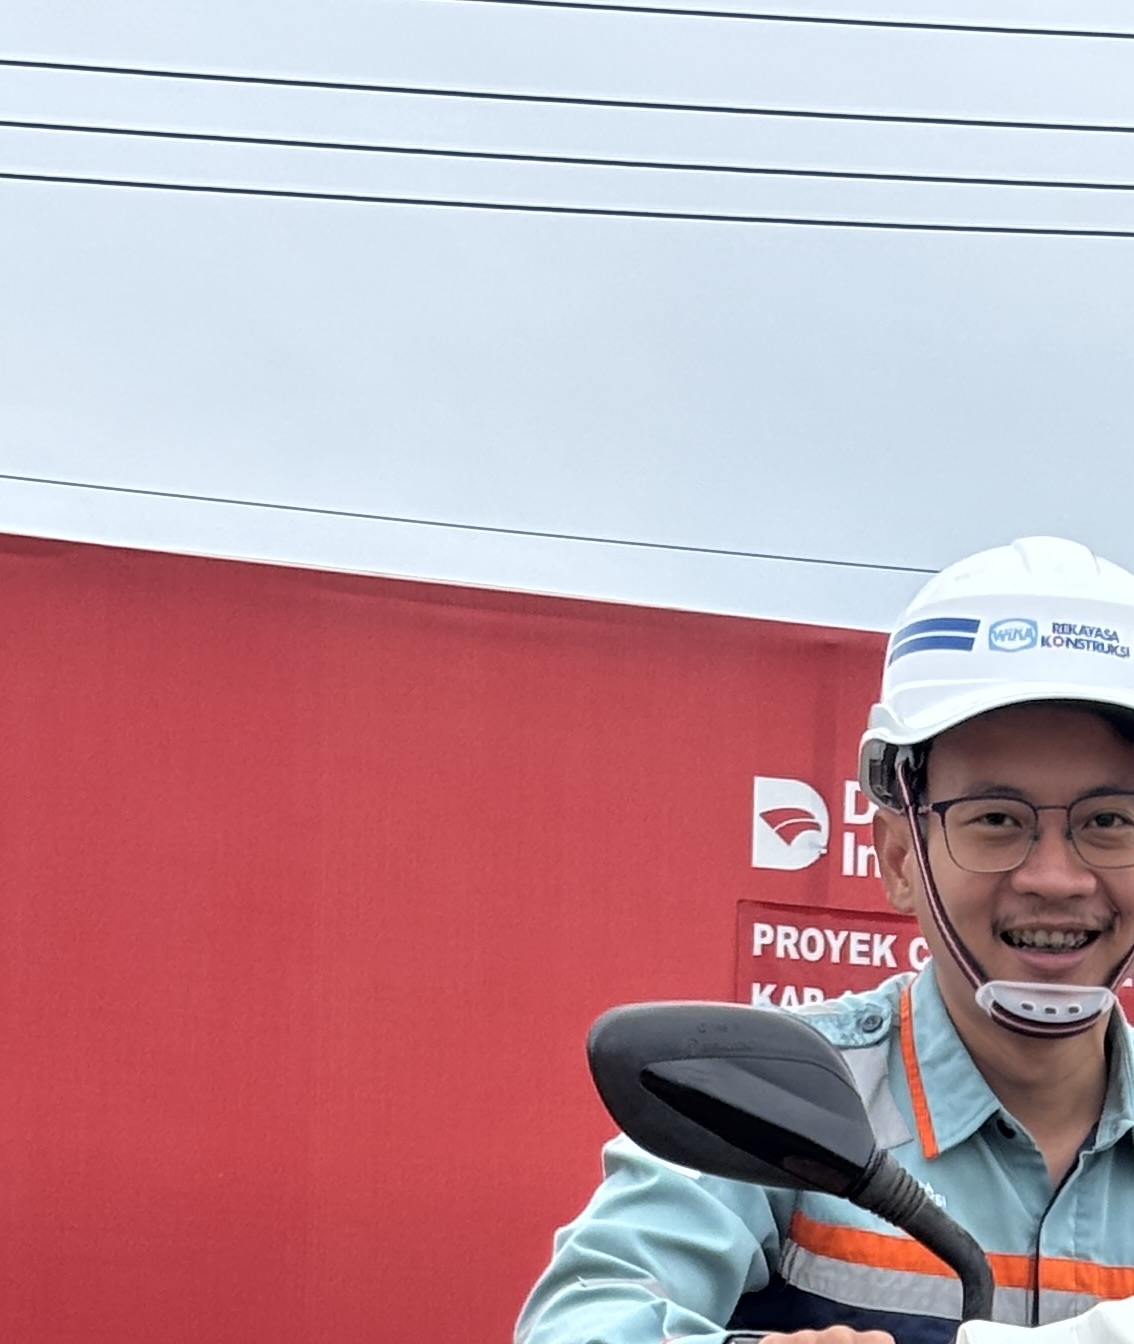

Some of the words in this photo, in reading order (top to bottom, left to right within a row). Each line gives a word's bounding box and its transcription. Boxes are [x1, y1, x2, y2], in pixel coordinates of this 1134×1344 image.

[1051, 622, 1119, 643] REKAYASA
[1041, 635, 1131, 659] KONSTRUKSI
[752, 922, 898, 968] PROYEK
